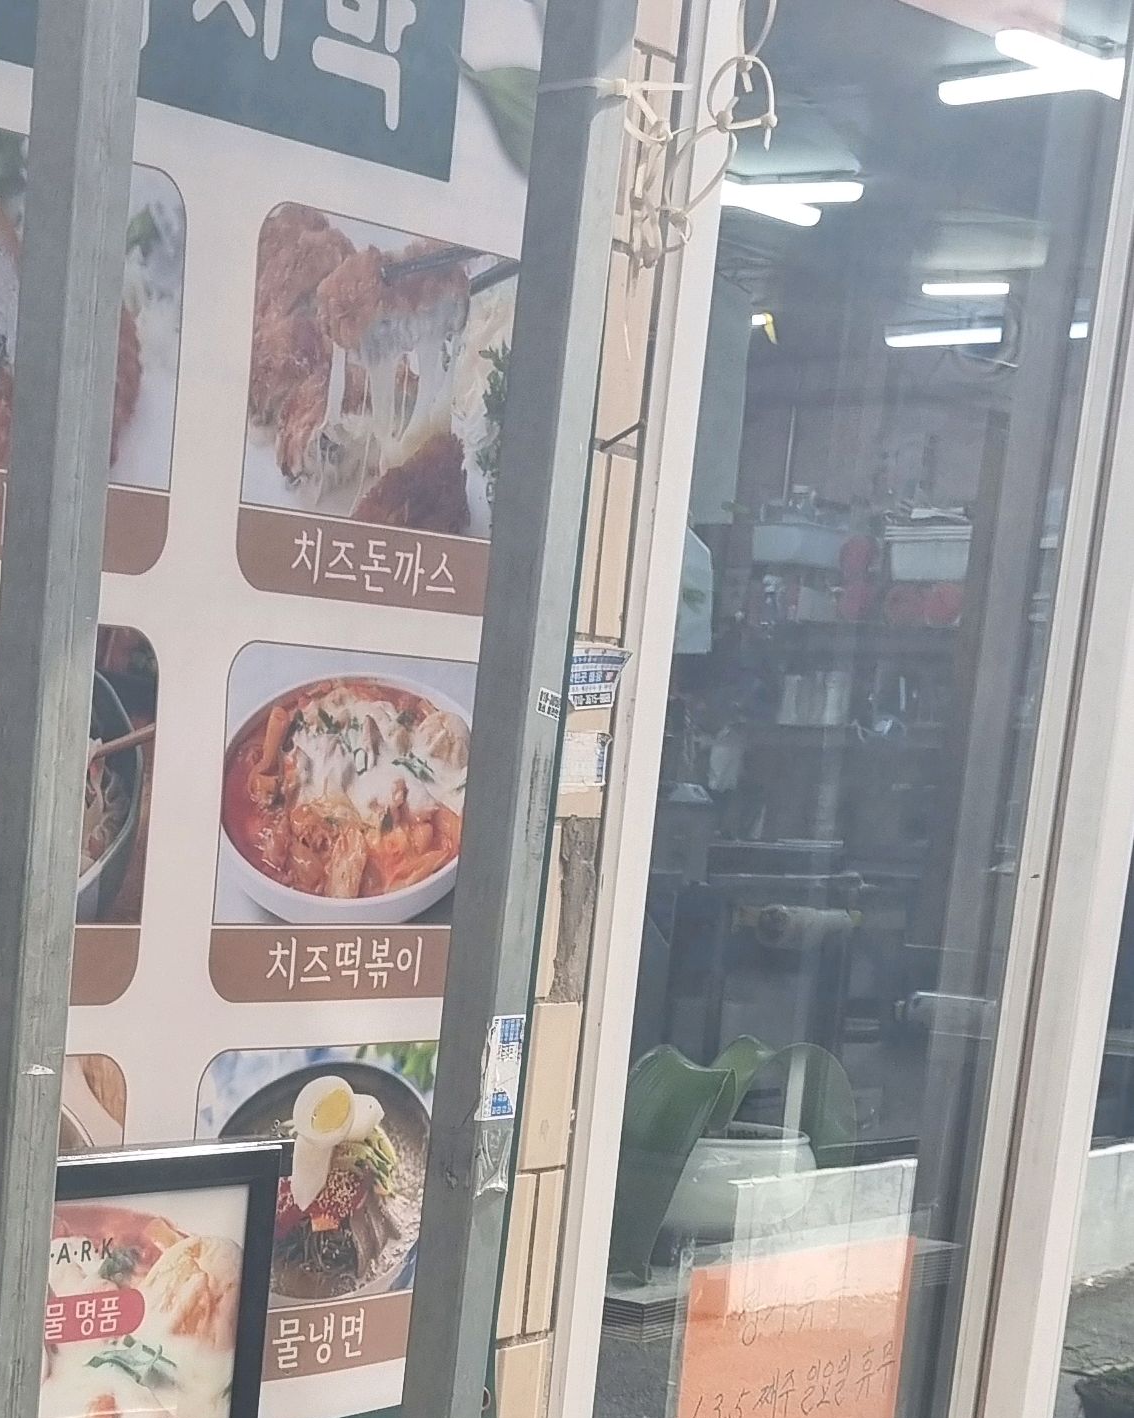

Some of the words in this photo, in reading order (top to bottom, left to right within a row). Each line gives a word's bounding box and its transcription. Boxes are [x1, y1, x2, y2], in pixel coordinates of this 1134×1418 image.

[291, 528, 457, 597] 치즈돈까스
[266, 937, 423, 988] 치즈떡볶이
[75, 1297, 121, 1336] 명품
[271, 1308, 366, 1371] 물냉면
